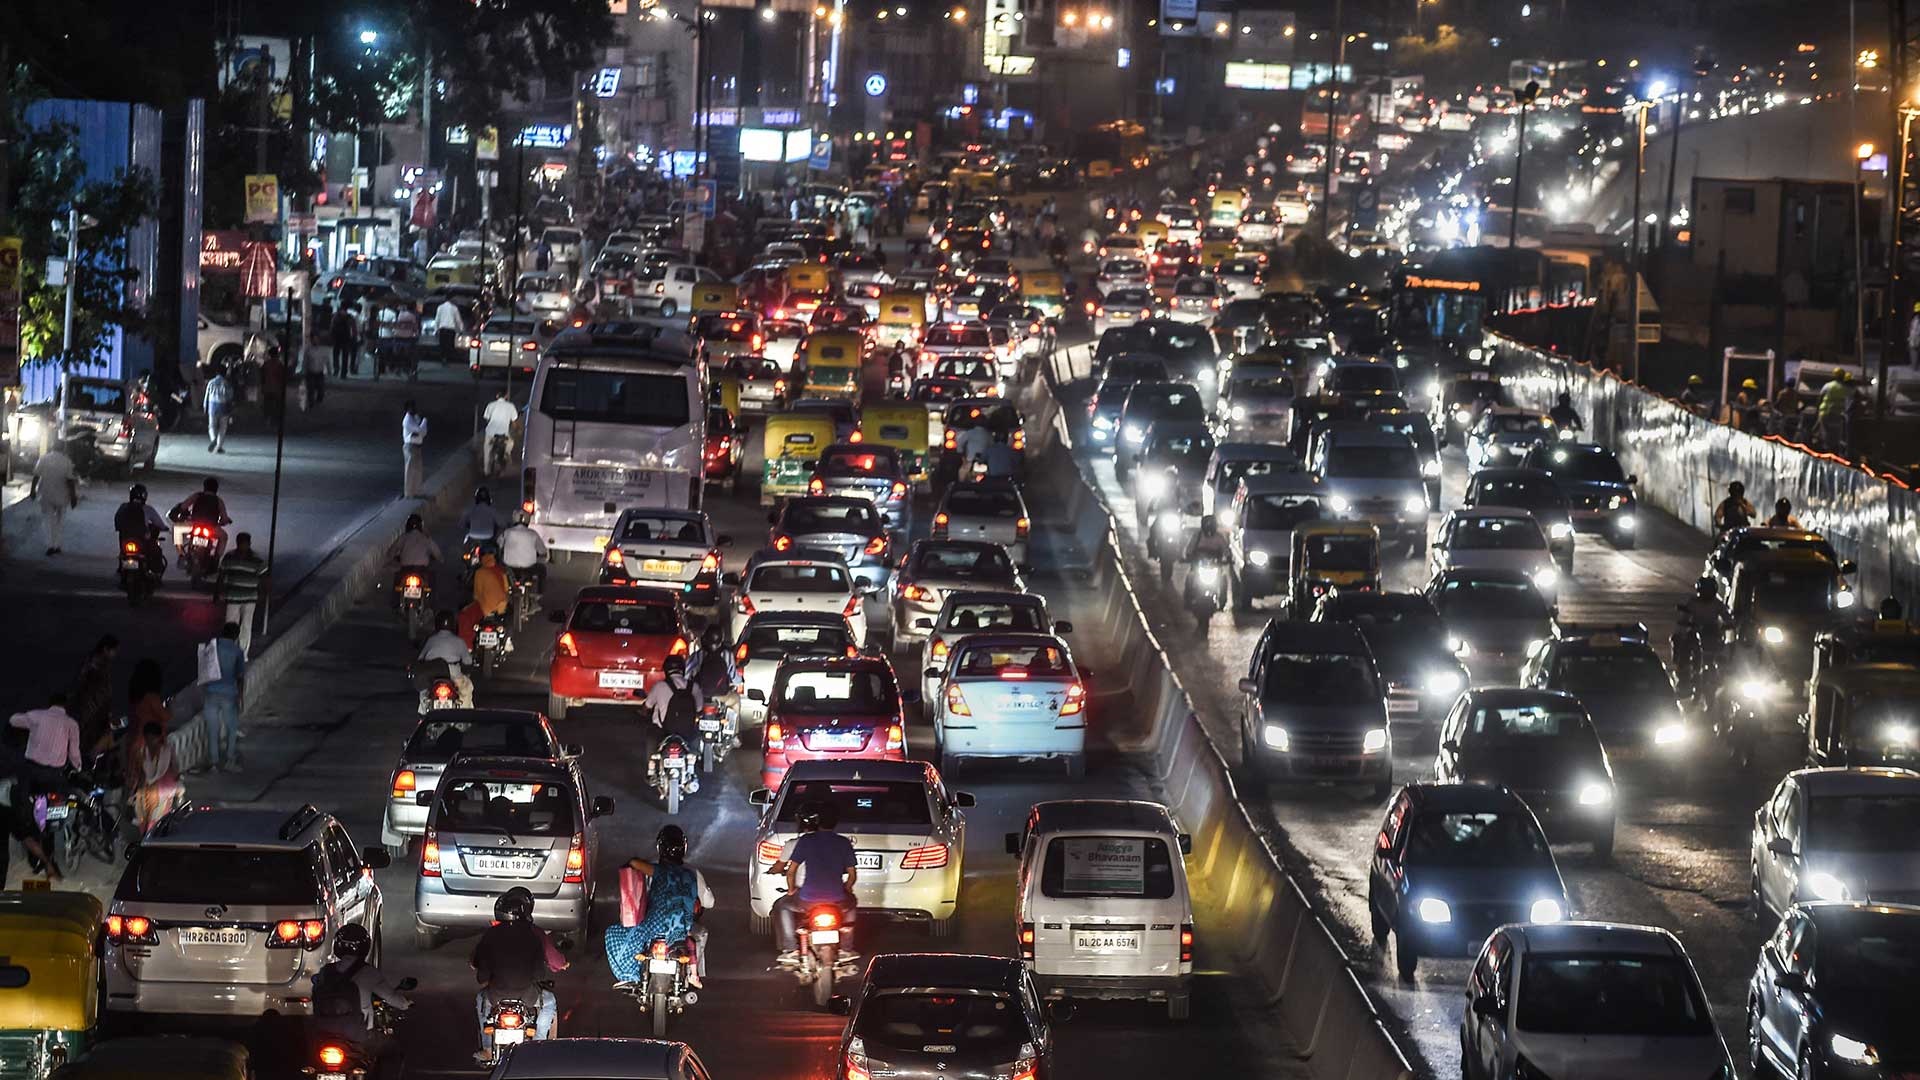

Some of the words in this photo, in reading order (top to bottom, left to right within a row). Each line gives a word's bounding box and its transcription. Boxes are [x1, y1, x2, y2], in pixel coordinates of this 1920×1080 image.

[1097, 842, 1133, 853] Arogya
[1088, 852, 1141, 862] Bhavanam
[1079, 938, 1089, 947] DL
[1091, 938, 1102, 947] 2C
[1104, 938, 1114, 947] AA
[1116, 938, 1135, 947] 6574
